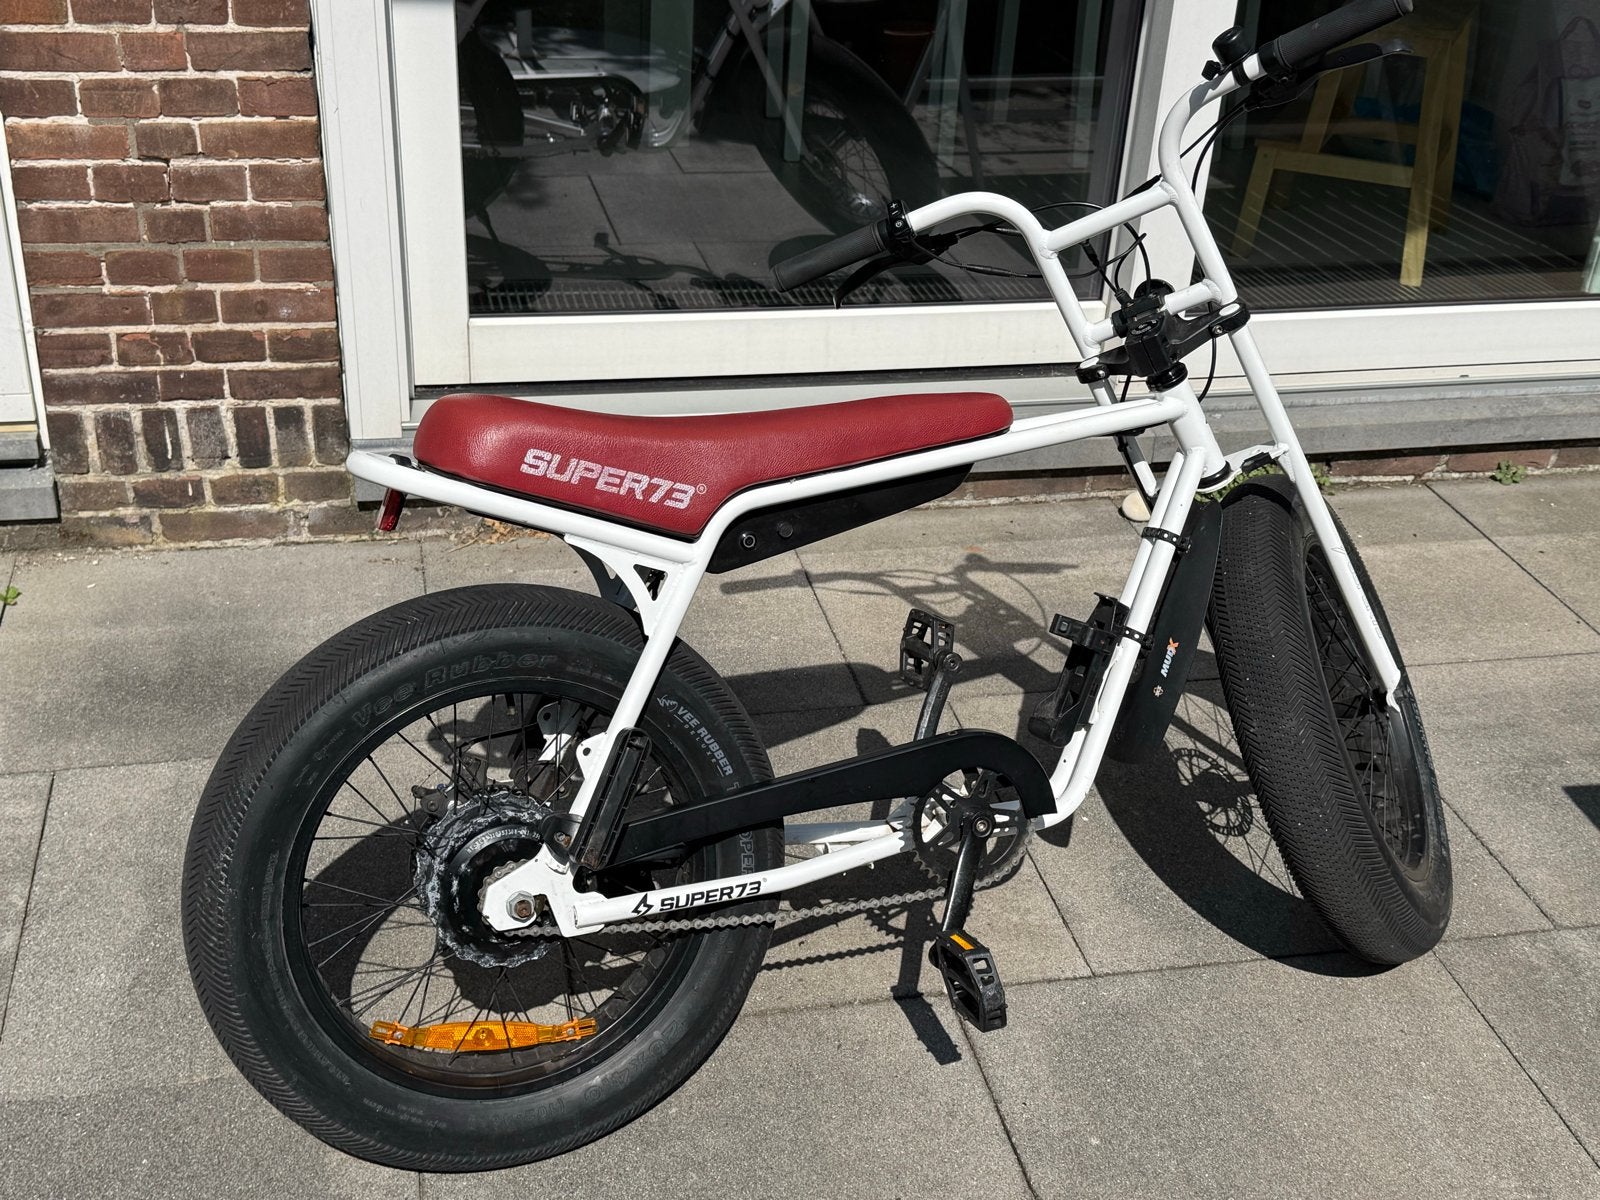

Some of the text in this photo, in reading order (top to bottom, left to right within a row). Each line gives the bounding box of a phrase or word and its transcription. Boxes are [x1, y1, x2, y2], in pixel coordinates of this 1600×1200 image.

[351, 682, 415, 728] Vee
[424, 651, 558, 689] Rubber
[677, 706, 700, 729] VEE
[697, 726, 734, 776] RUBBER
